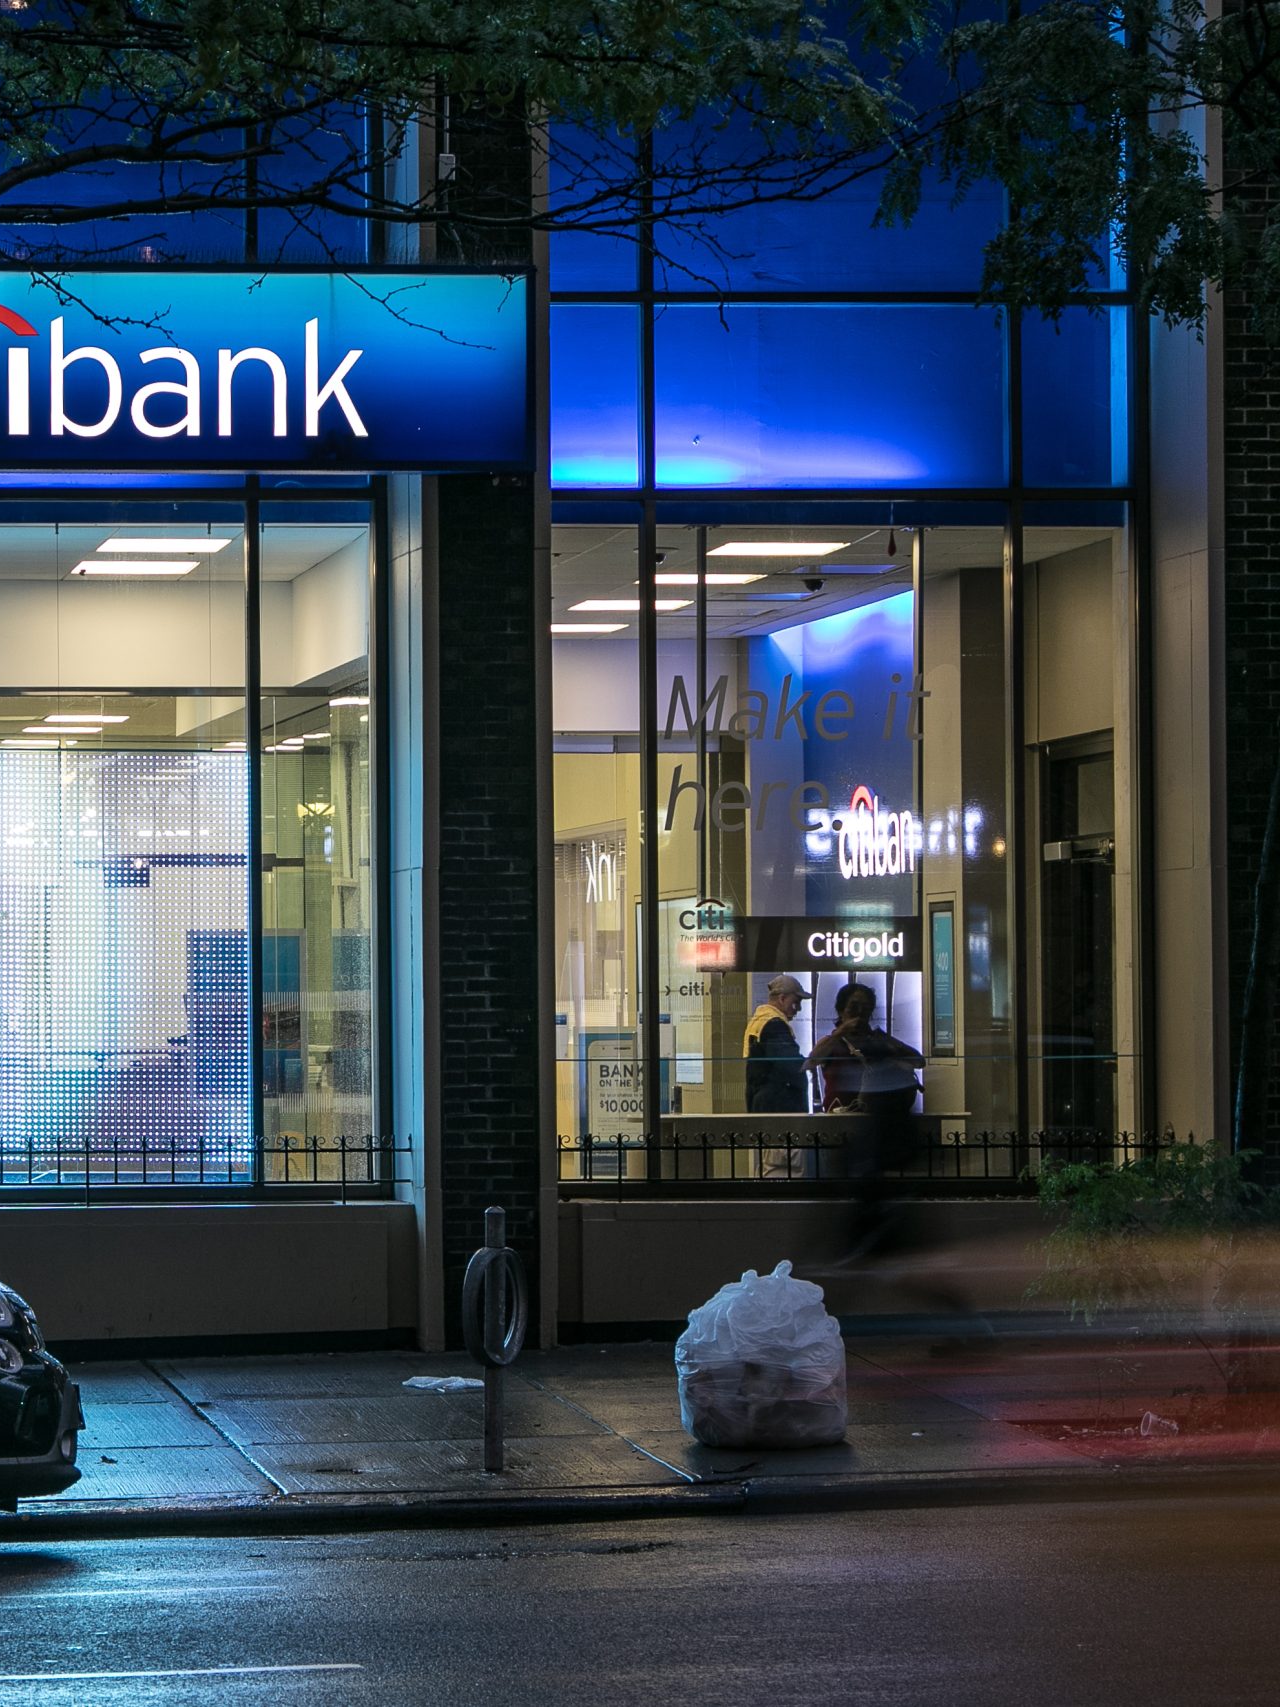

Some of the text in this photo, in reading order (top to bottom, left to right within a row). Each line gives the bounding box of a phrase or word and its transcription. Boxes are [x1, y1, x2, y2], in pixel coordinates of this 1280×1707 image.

[664, 673, 931, 741] Make it
[664, 764, 843, 832] here.
[679, 904, 724, 930] citi
[680, 934, 695, 942] The
[808, 932, 904, 962] Citigold
[599, 1064, 643, 1078] BANK
[599, 1079, 612, 1088] ON
[614, 1079, 632, 1088] THE
